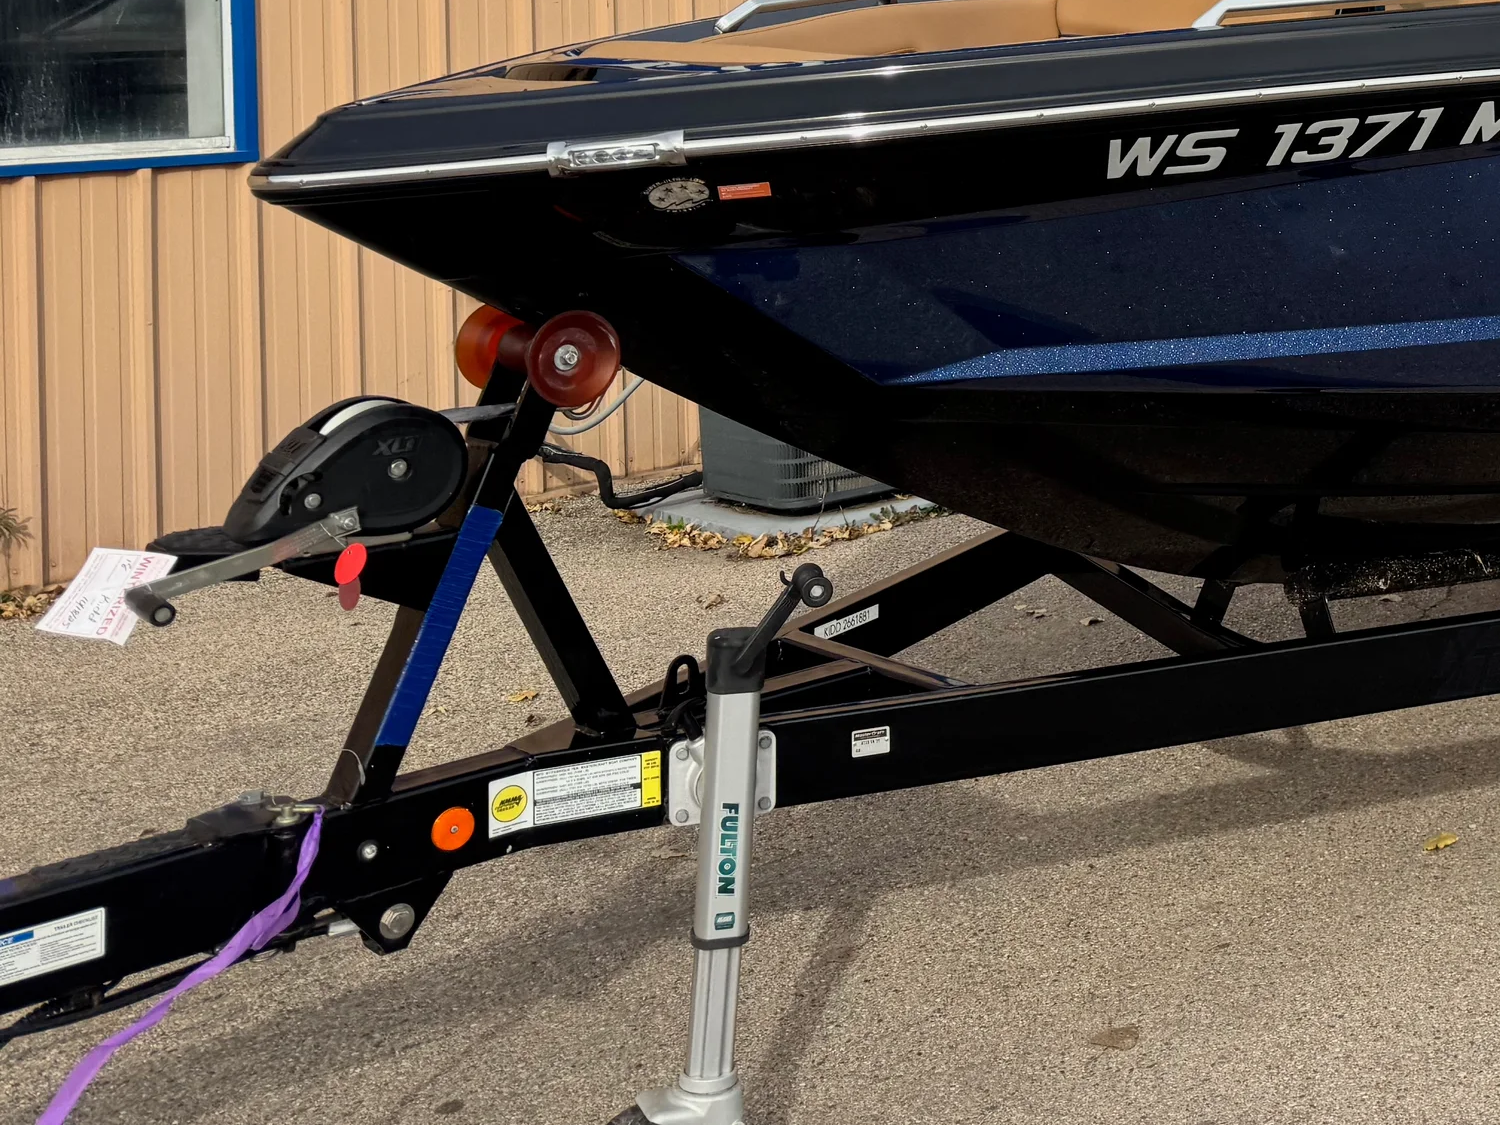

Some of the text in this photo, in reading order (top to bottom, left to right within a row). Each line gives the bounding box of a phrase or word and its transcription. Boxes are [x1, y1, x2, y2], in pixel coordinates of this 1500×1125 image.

[1106, 128, 1240, 179] WS
[1264, 106, 1445, 167] 1371
[96, 556, 156, 636] WINTRIZED
[823, 622, 841, 637] KIDD
[717, 803, 740, 894] FULTON
